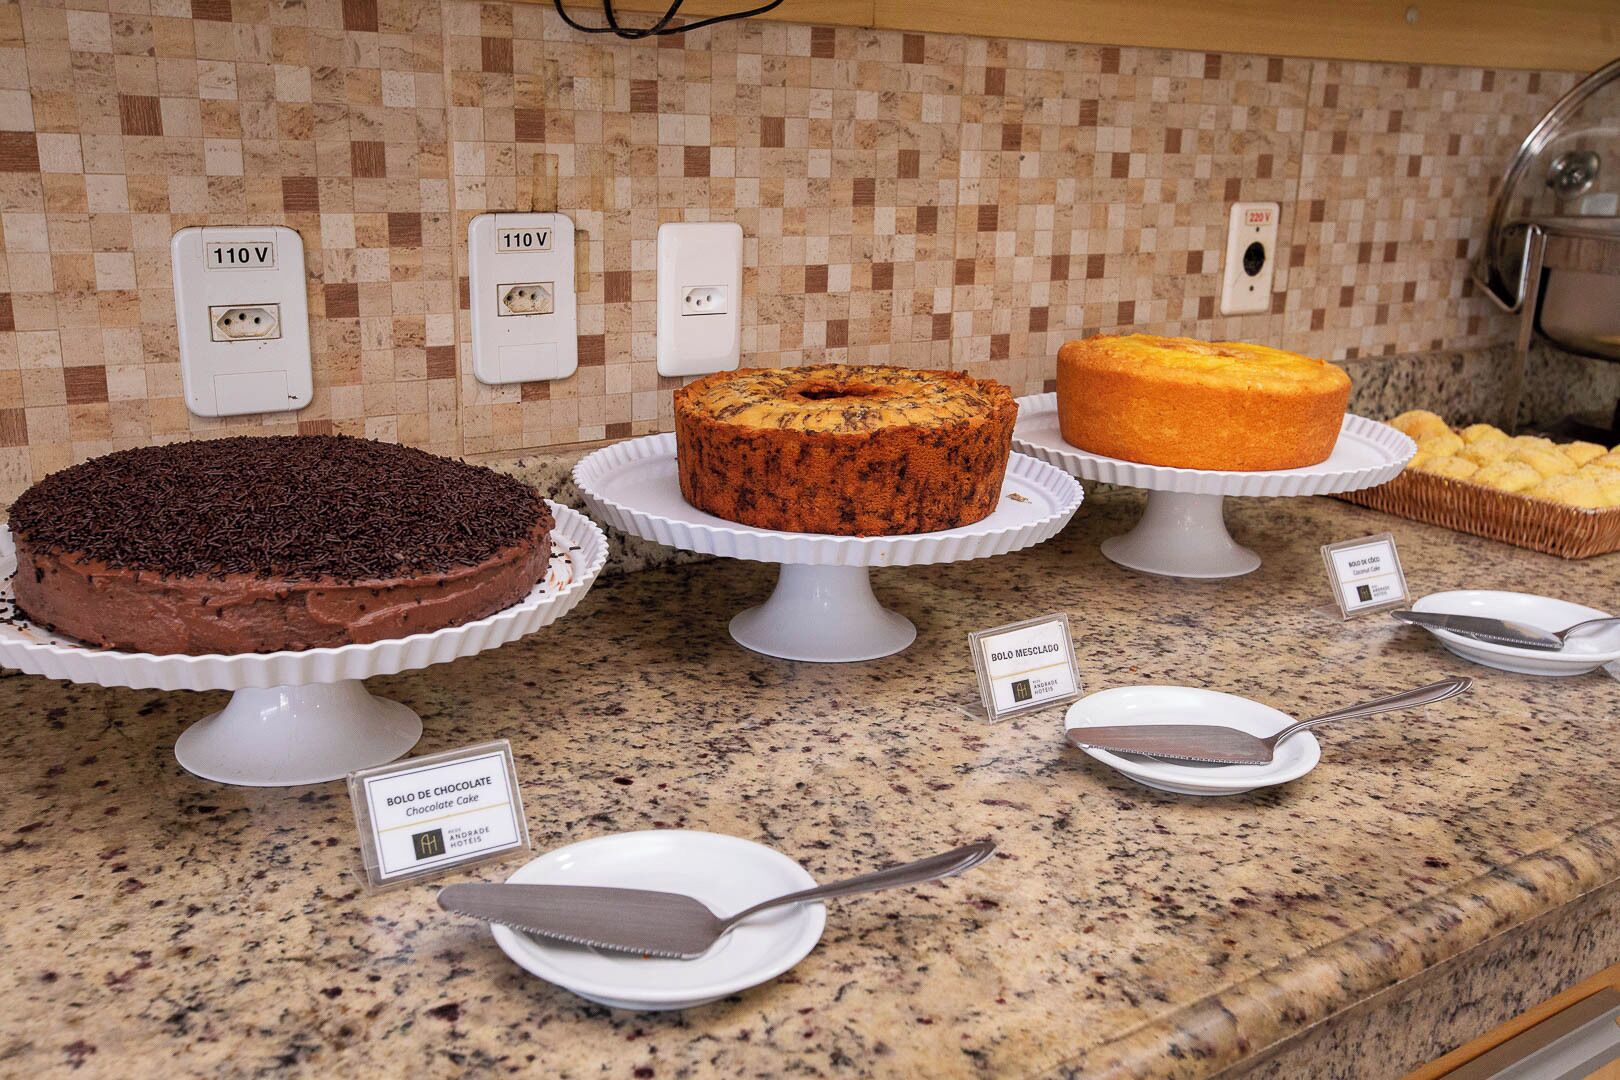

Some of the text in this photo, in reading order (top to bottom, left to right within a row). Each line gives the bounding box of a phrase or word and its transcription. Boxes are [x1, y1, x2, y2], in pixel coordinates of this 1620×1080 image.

[1249, 211, 1272, 222] 220 V
[504, 232, 548, 248] 110 V
[214, 247, 268, 264] 110 V
[991, 644, 1059, 662] BOLO MESCLADO
[1034, 680, 1058, 689] ANDRADE
[386, 776, 492, 806] BOLO DE CHOCOLATE
[406, 794, 479, 817] Chocolate Cake
[449, 826, 490, 842] ANDRADE
